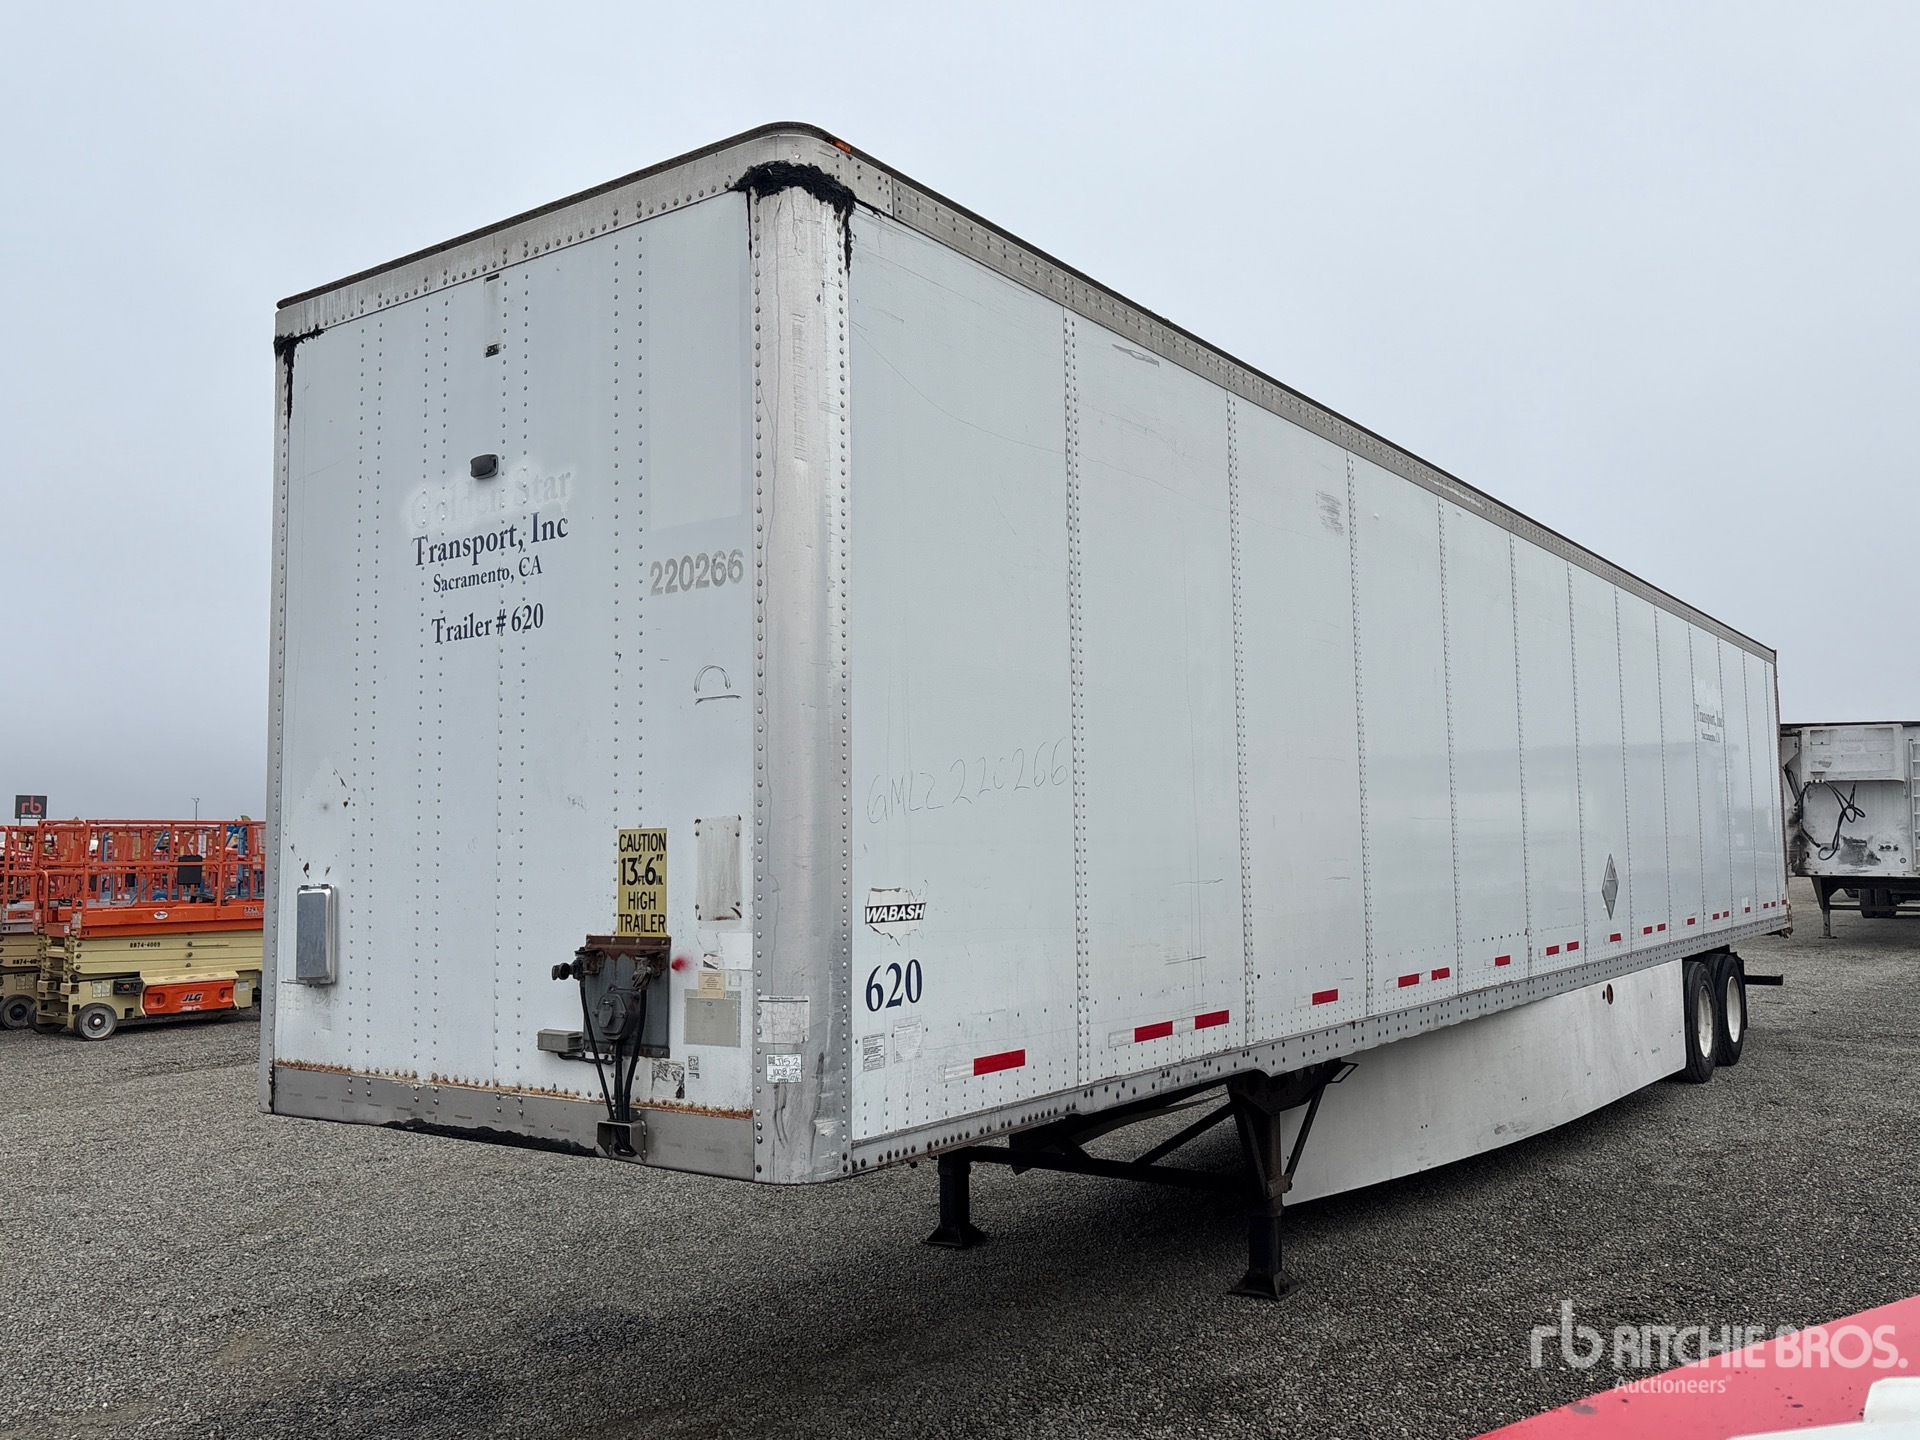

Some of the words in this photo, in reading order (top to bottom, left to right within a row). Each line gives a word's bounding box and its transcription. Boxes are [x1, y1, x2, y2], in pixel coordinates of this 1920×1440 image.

[411, 525, 525, 567] Transport,
[530, 511, 569, 544] Inc
[433, 565, 515, 593] Sacramento,
[518, 555, 543, 577] CA
[649, 548, 745, 596] 220266
[431, 612, 493, 644] Trailer
[495, 608, 507, 635] #
[511, 603, 544, 632] 620
[21, 796, 43, 814] rb
[619, 832, 667, 852] CAUTION
[627, 891, 657, 910] HIGH
[619, 913, 666, 933] TRAILER
[866, 903, 925, 923] WABASH
[865, 958, 923, 1012] 620
[181, 993, 203, 1002] JLG
